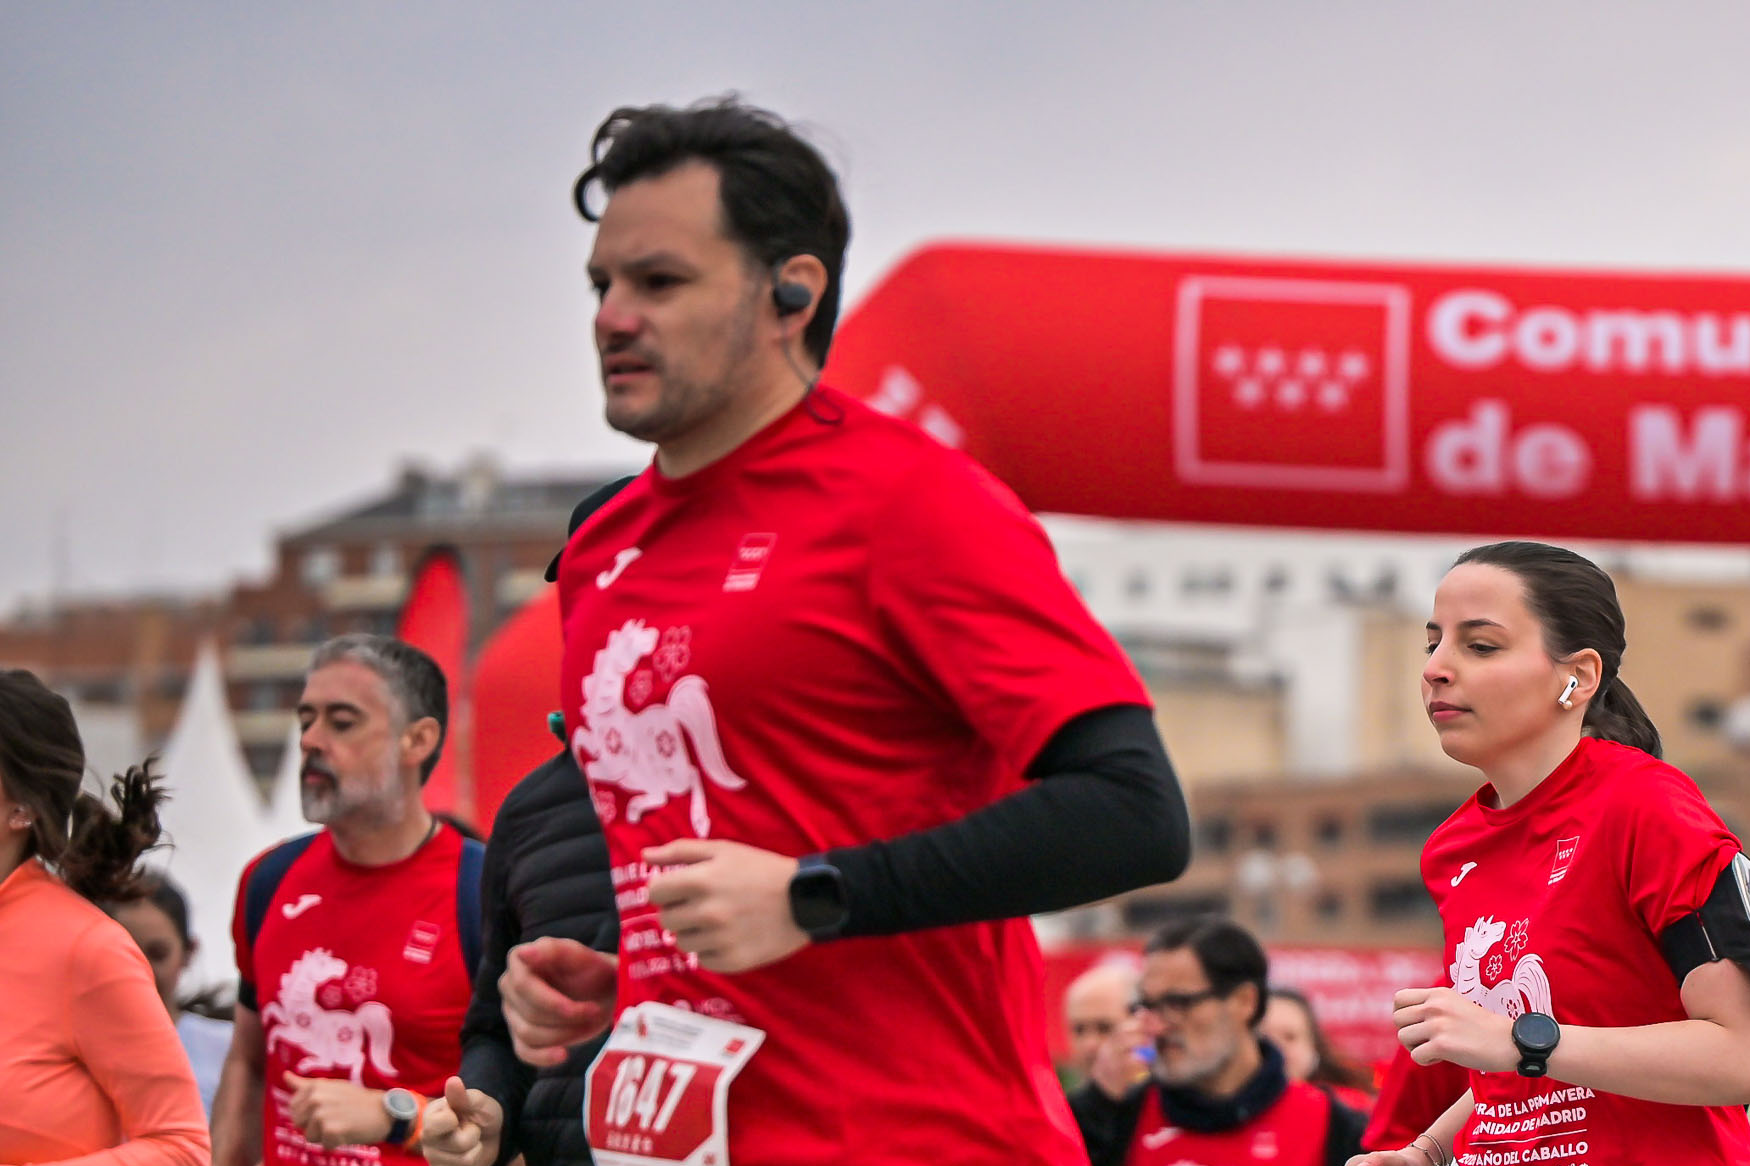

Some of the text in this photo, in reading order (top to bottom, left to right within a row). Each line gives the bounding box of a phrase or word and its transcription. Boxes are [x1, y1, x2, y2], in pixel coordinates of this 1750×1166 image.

[1425, 400, 1591, 498] de
[605, 1055, 698, 1132] 1647
[1497, 1103, 1513, 1118] DE
[1513, 1100, 1529, 1115] LA
[1521, 1118, 1536, 1132] DE
[1475, 1149, 1503, 1166] AÑO
[1503, 1150, 1520, 1166] DEL
[1522, 1141, 1589, 1163] CABALLO
